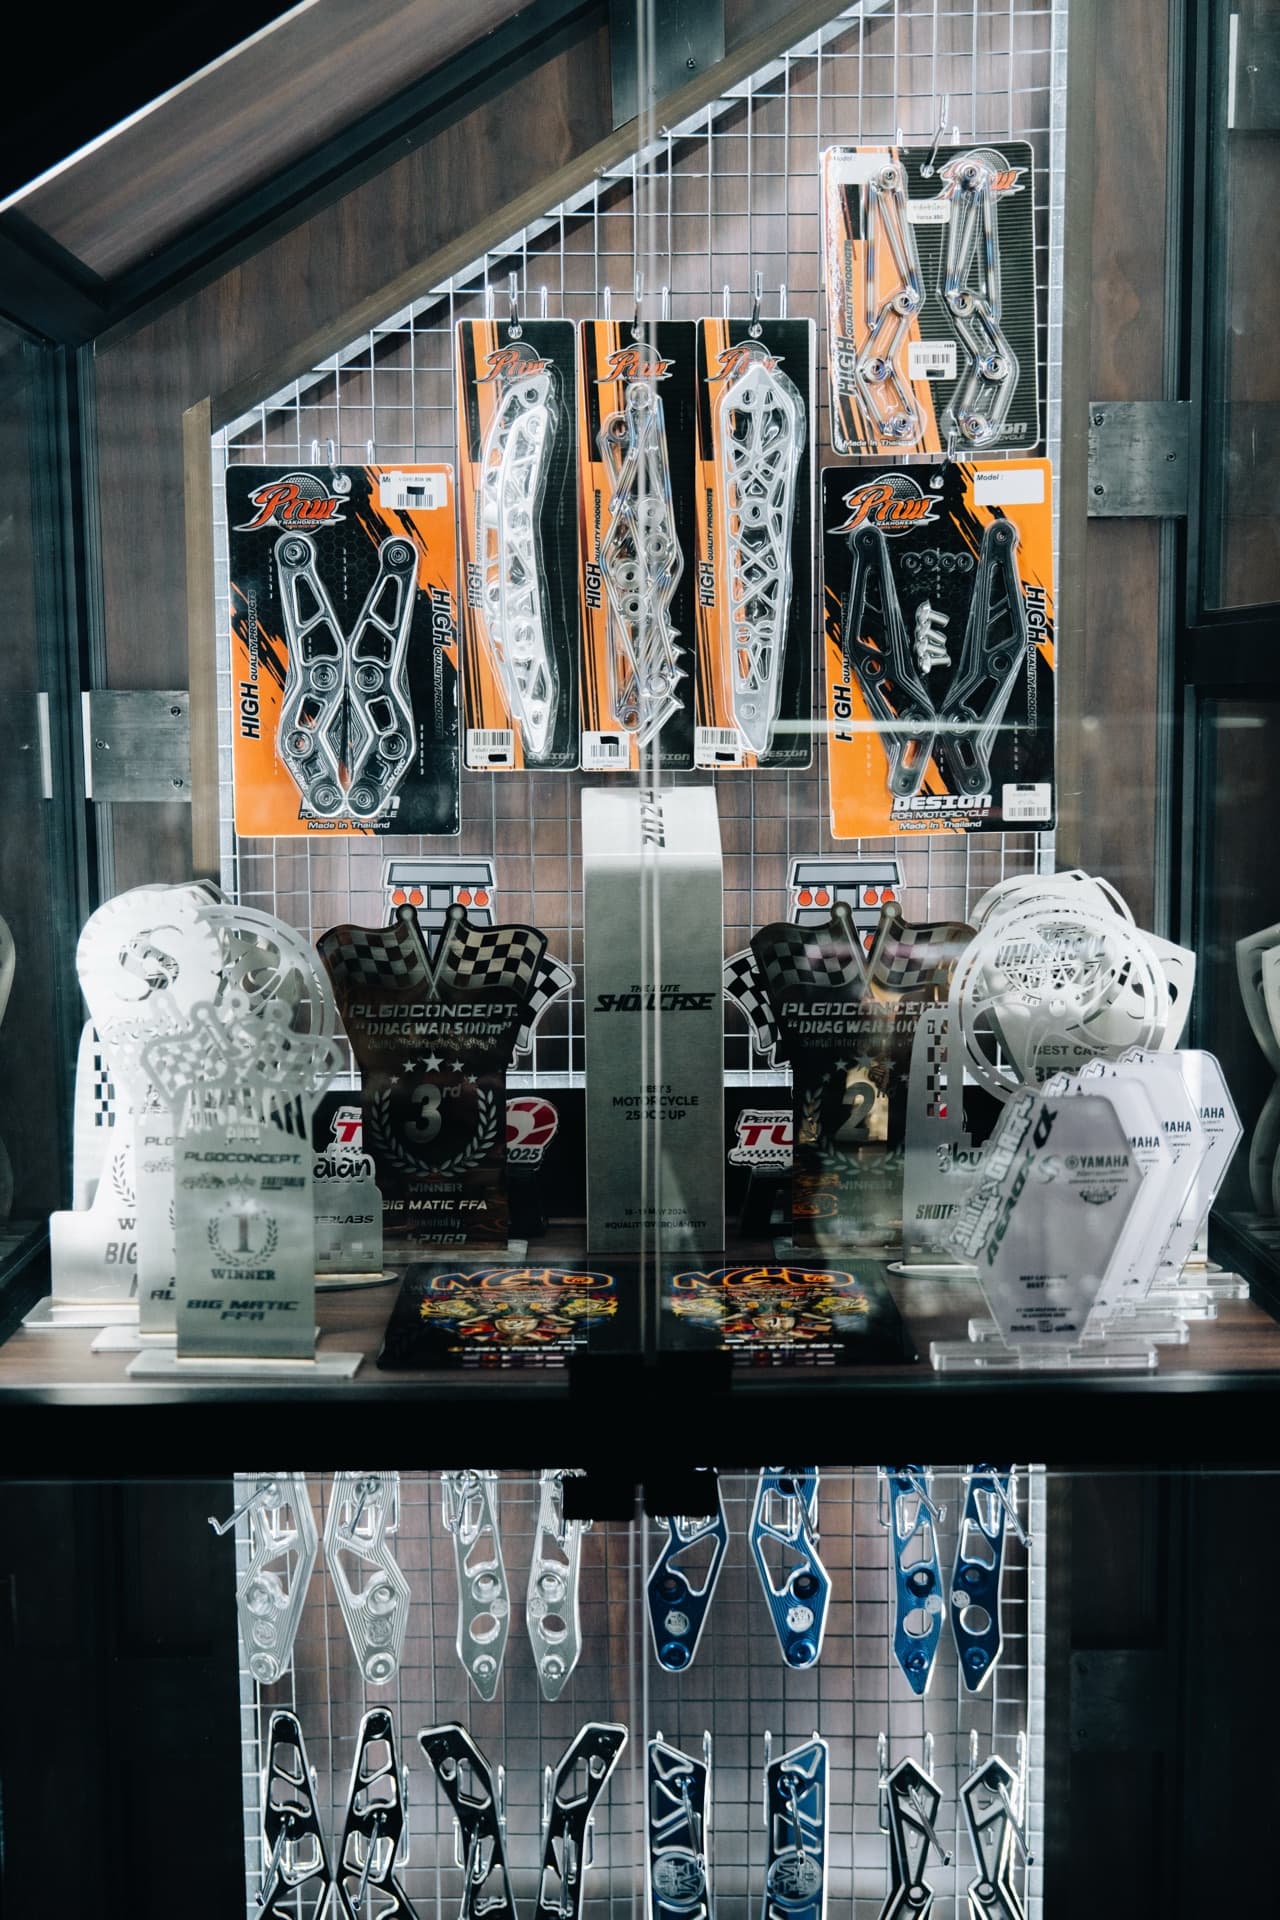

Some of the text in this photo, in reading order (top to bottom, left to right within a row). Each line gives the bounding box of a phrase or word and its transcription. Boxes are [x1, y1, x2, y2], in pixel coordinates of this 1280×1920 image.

[837, 336, 856, 396] HIGH
[468, 562, 483, 609] HIGH
[586, 562, 601, 609] HIGH
[700, 560, 715, 608] HIGH
[432, 588, 451, 647] HIGH
[1027, 586, 1046, 644] HIGH
[240, 682, 260, 739] HIGH
[833, 685, 852, 741] HGH
[308, 821, 335, 829] Made
[351, 821, 390, 829] Thailand
[900, 822, 927, 830] Made
[943, 820, 982, 828] Thailand
[916, 809, 990, 819] MOTORCYCLE
[668, 1110, 686, 1120] UP
[1080, 1156, 1129, 1169] YAMAHA
[409, 1200, 454, 1210] MATIC
[459, 1200, 488, 1210] FFA
[211, 1268, 276, 1281] WINNER
[186, 1300, 299, 1311] BIG MATIC
